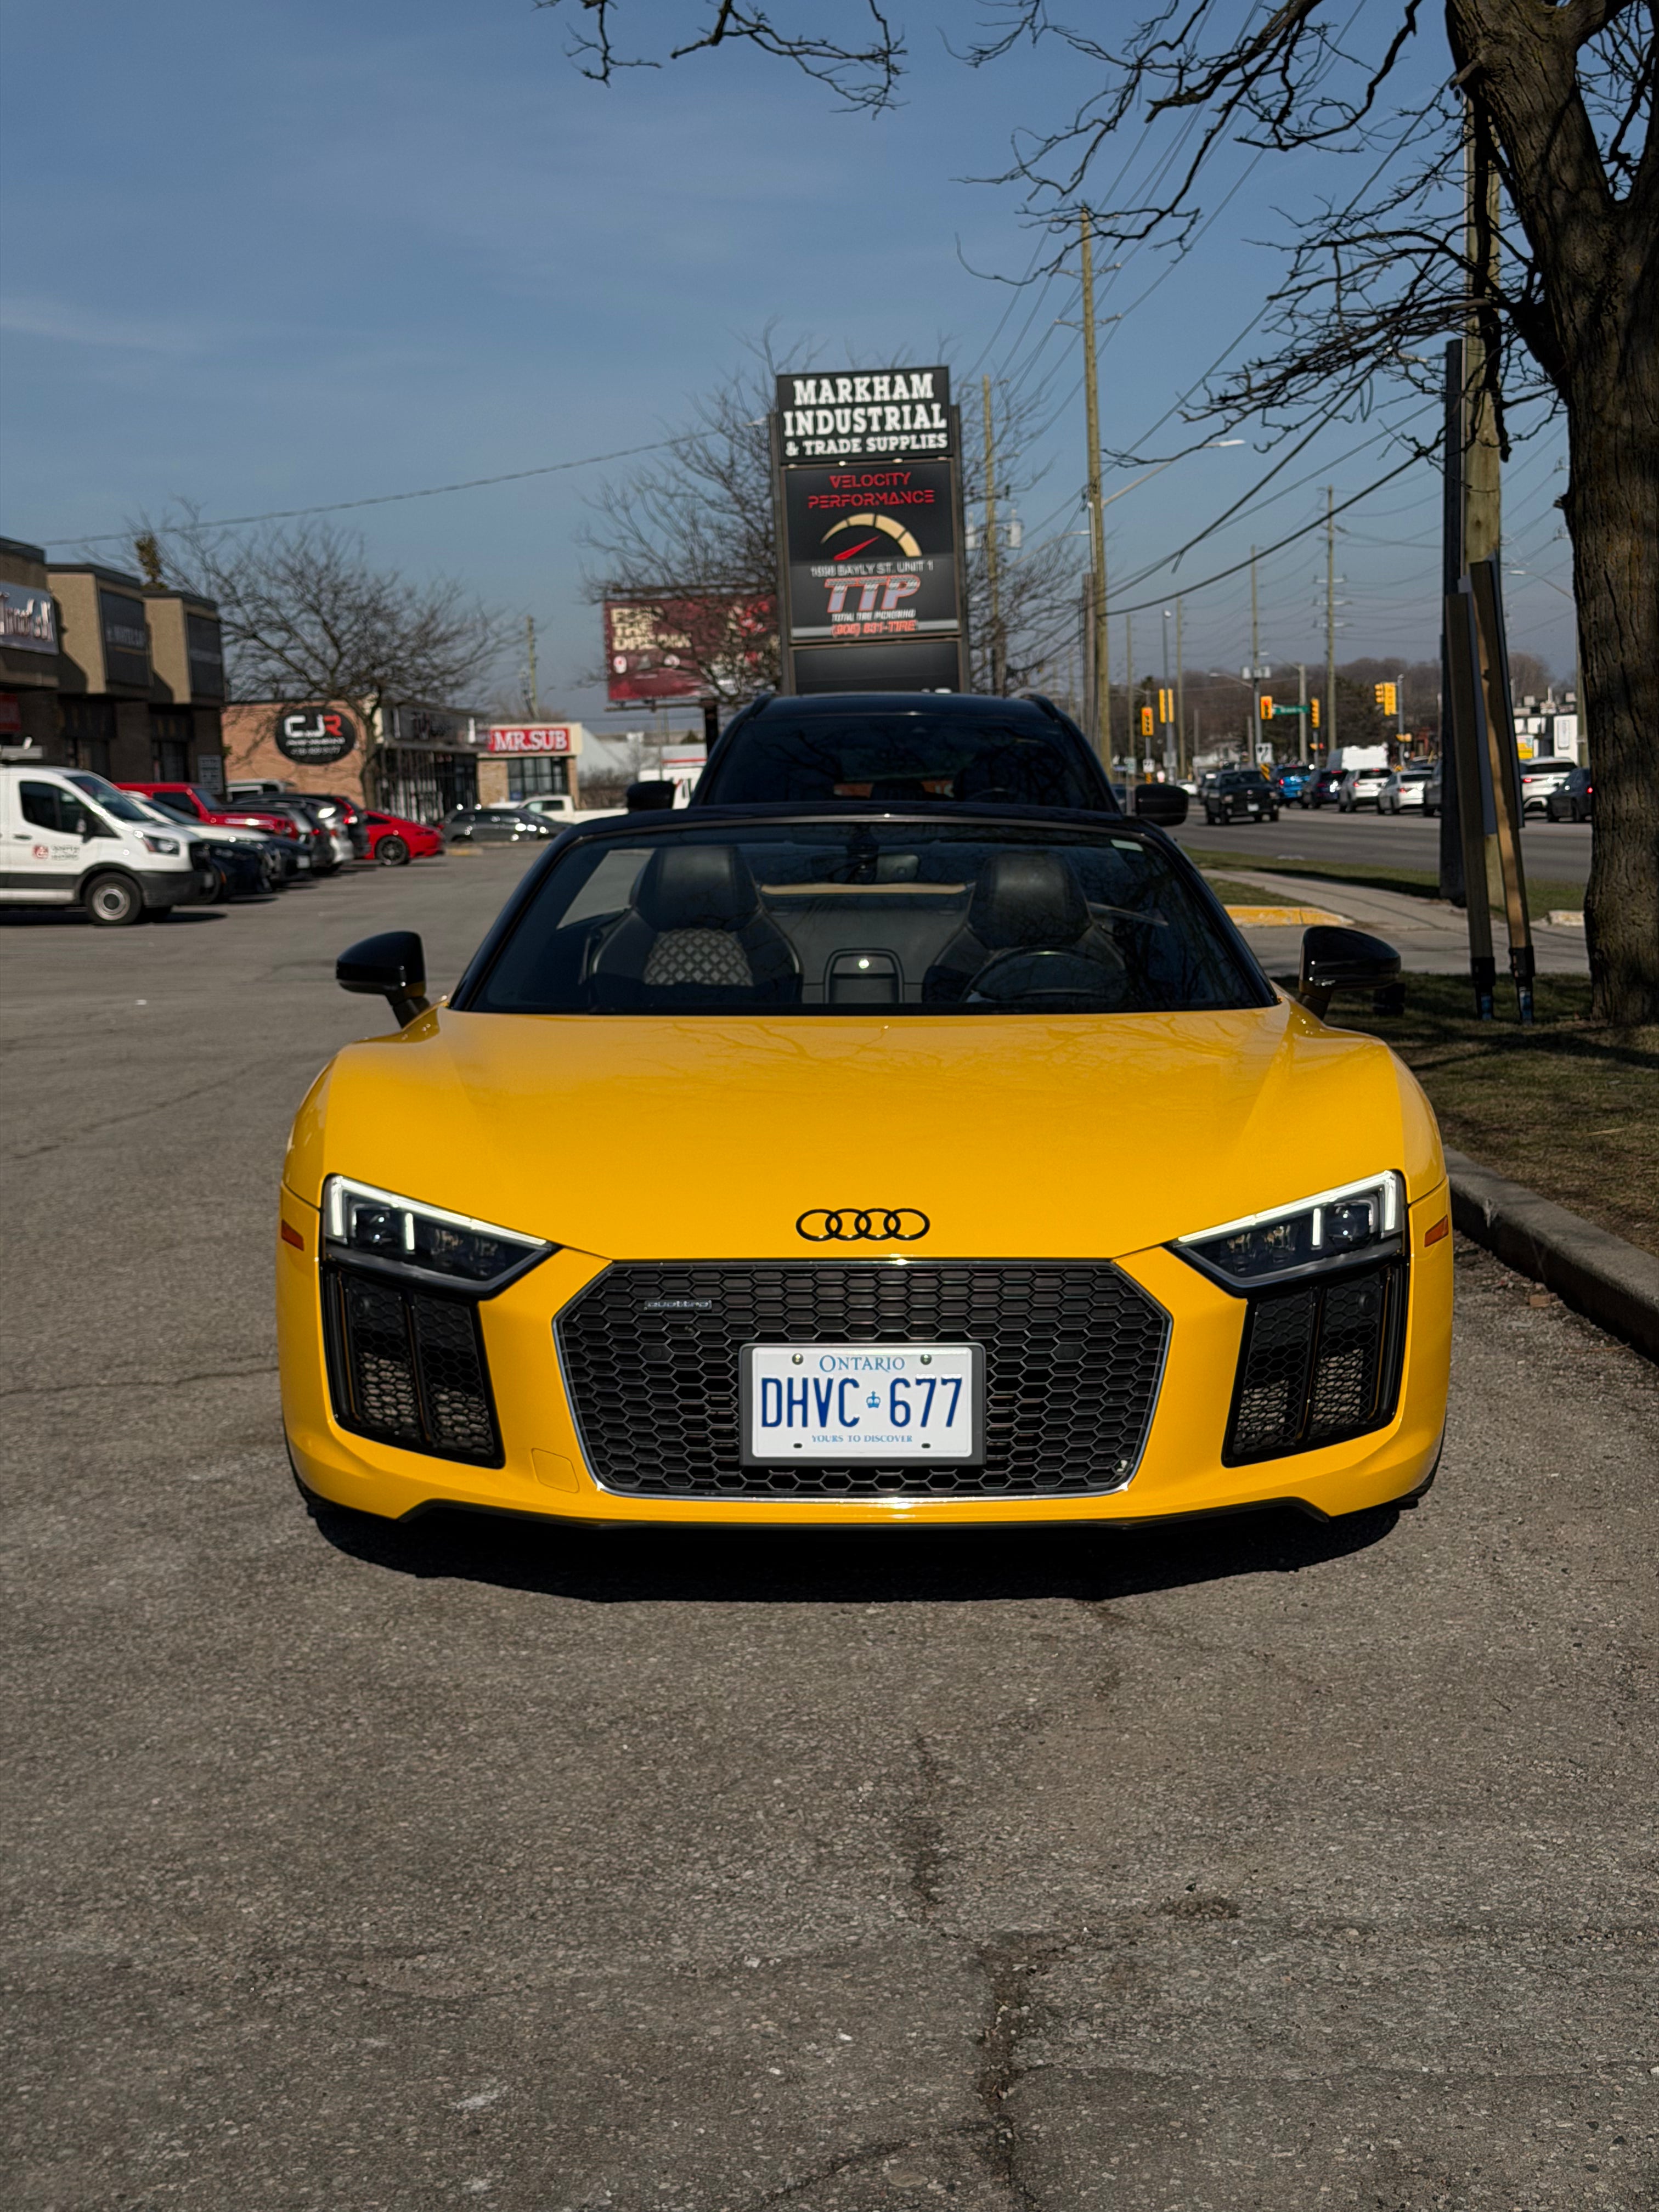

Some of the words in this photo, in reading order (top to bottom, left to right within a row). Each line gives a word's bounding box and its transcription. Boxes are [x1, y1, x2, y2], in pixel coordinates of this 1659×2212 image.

[793, 373, 934, 406] MARKHAM
[783, 403, 947, 437] INDUSTRIAL
[785, 441, 799, 457] &
[803, 437, 862, 456] TRADE
[866, 432, 948, 452] SUPPLIES
[829, 472, 911, 489] VELOCITY
[808, 489, 935, 509] PERFORMANCE
[838, 563, 876, 576] BAYLY
[896, 561, 923, 573] UNIT
[824, 574, 921, 613] TTP
[819, 1355, 905, 1373] ONTARIO
[761, 1377, 860, 1427] DHVC
[889, 1374, 962, 1427] 677
